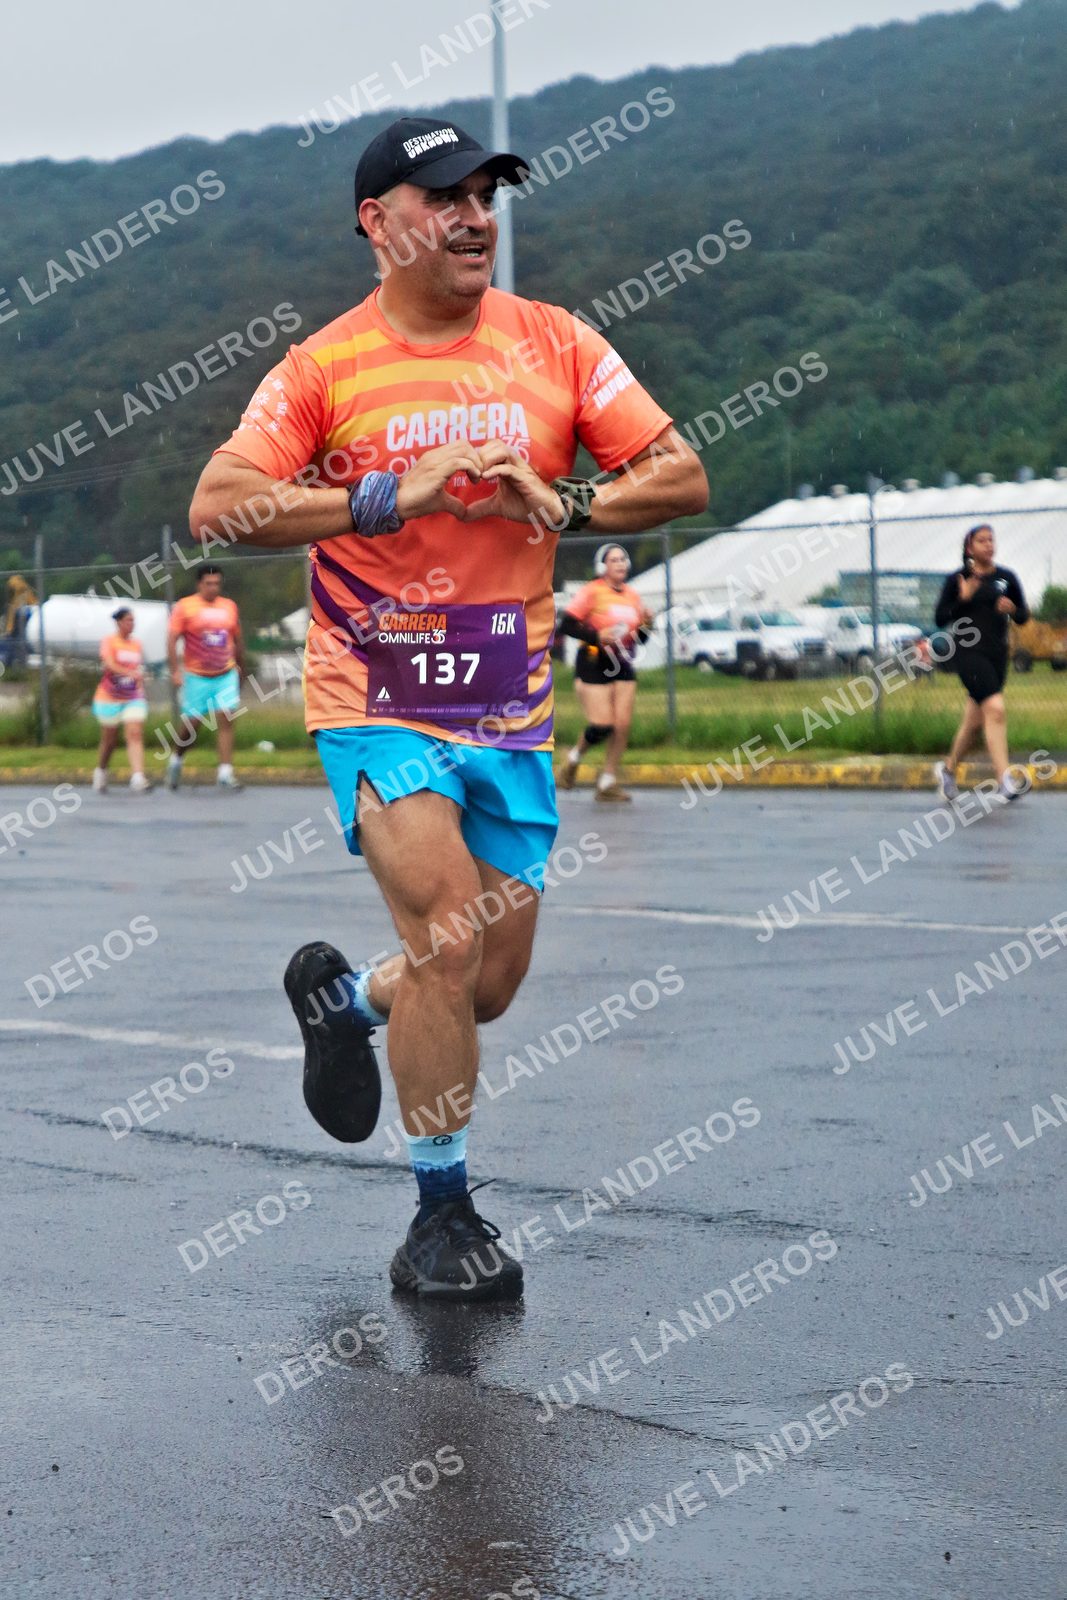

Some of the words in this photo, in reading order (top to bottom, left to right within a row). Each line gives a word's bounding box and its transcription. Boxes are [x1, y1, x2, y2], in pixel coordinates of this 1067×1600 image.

[408, 134, 459, 158] UNKNOWN
[386, 402, 529, 452] CARRERA
[378, 612, 447, 632] CARRERA
[491, 613, 516, 634] 15K
[378, 632, 431, 644] OMNILIFE
[410, 652, 480, 685] 137
